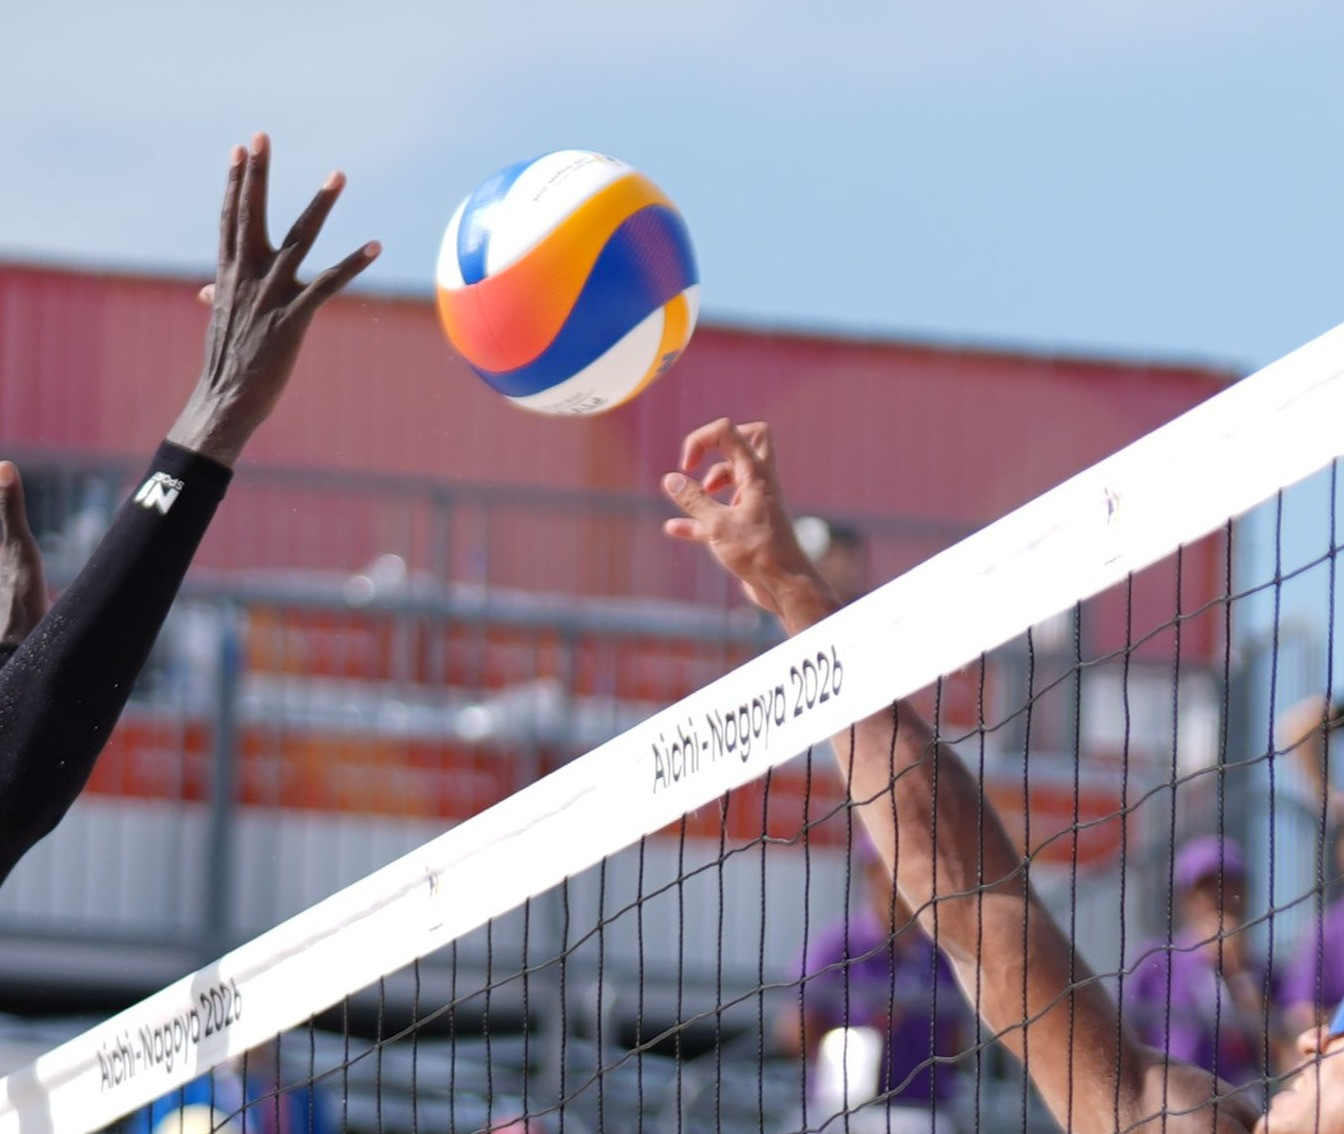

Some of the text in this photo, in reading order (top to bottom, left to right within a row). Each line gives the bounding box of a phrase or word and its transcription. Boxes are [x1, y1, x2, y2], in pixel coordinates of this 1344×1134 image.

[651, 644, 843, 794] Aichi-Nagoya 2026
[96, 976, 243, 1092] Aichi-Nagoya 2026
